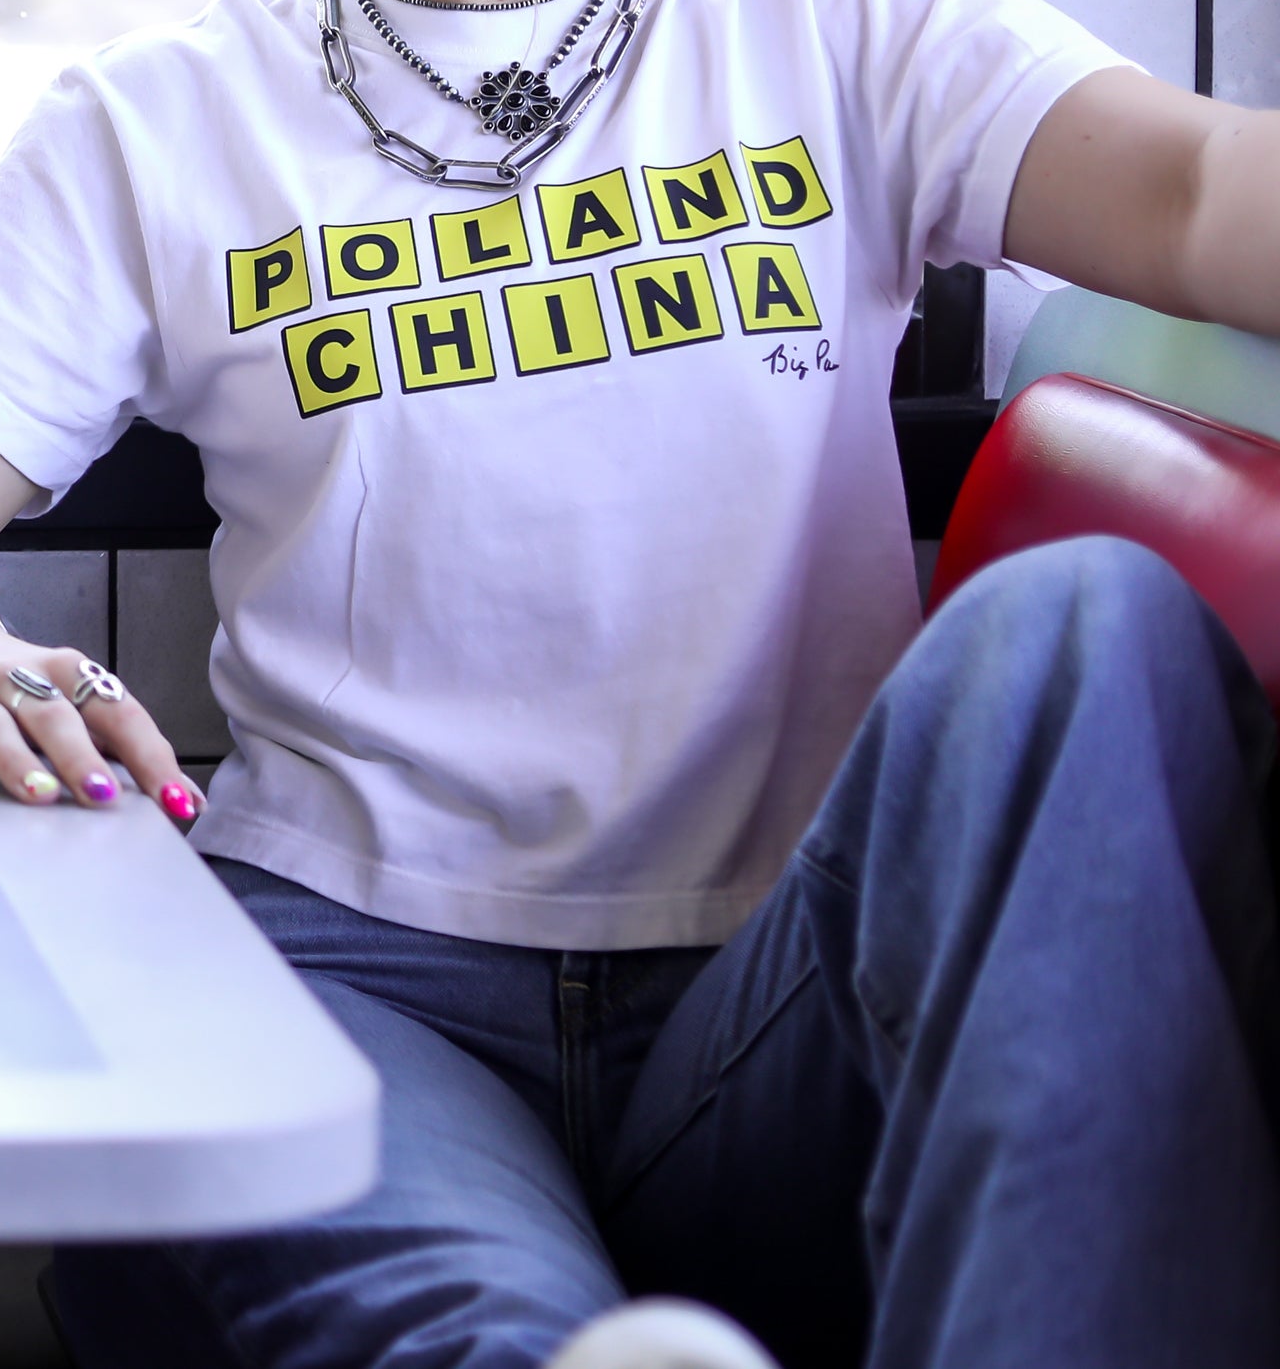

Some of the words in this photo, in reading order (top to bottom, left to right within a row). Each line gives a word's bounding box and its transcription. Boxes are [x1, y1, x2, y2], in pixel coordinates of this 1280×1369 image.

[254, 160, 808, 312] POLAND
[306, 256, 804, 394] CHINA
[762, 343, 809, 381] Big
